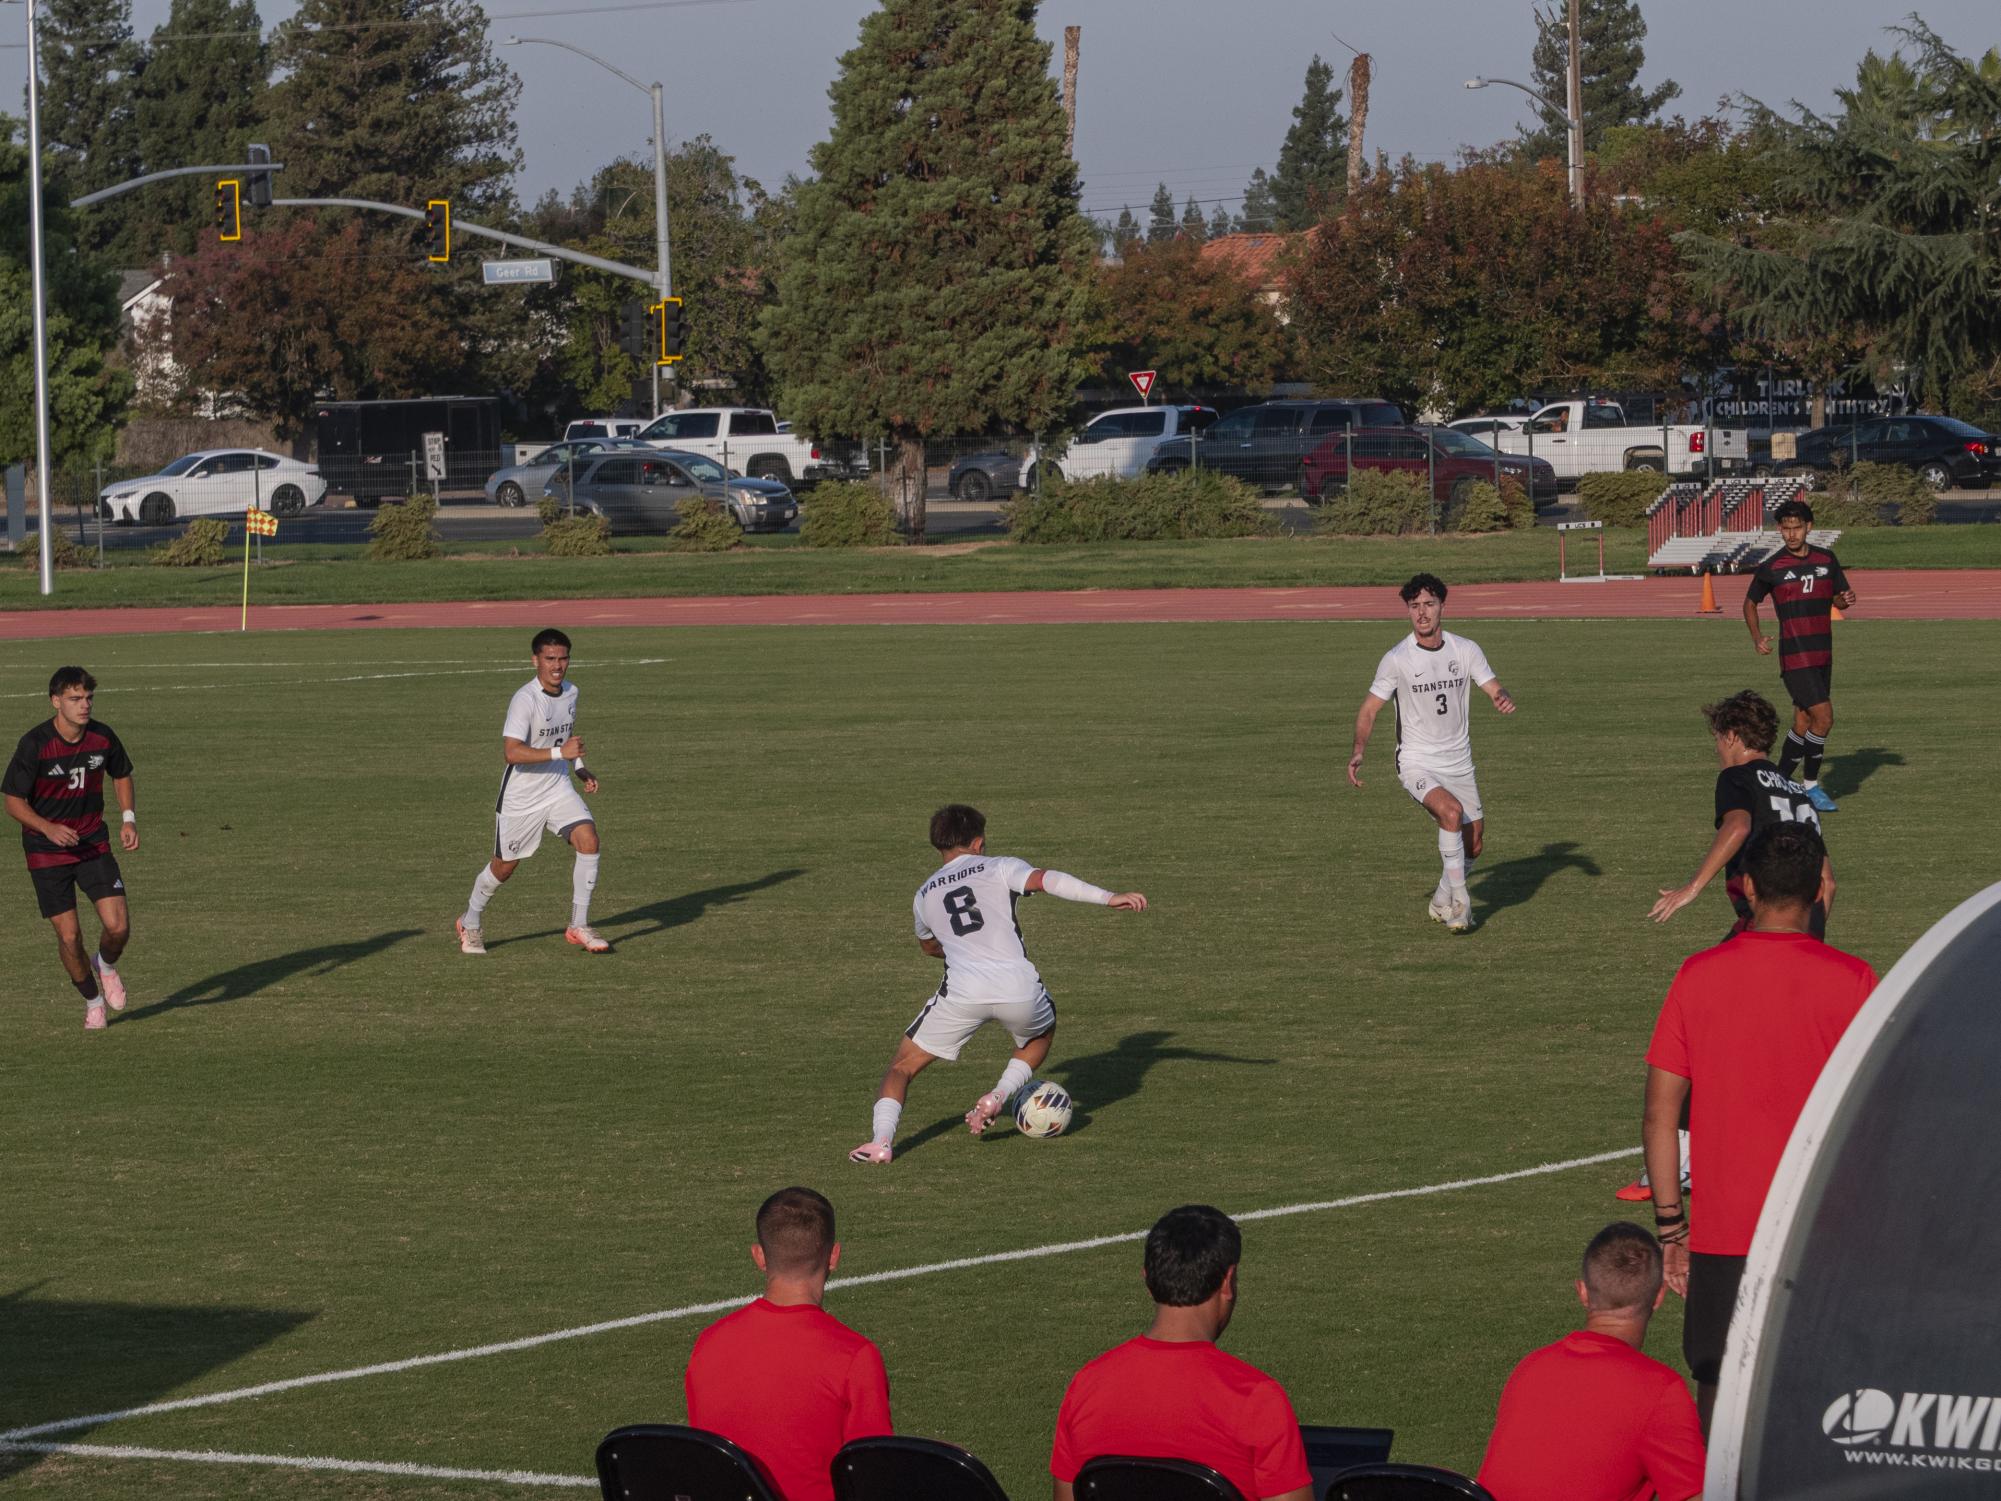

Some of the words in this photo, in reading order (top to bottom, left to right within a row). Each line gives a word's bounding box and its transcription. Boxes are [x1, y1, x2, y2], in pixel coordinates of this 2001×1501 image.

[496, 267, 520, 277] Geer
[525, 265, 538, 276] Rd
[1715, 401, 1800, 416] CHILDREN'S
[1806, 399, 1888, 415] DNTISTRY
[1800, 574, 1814, 594] 27
[1412, 682, 1437, 693] STAN
[1437, 678, 1464, 690] STATE
[1436, 693, 1448, 715] 3
[539, 726, 560, 737] STAN
[68, 767, 86, 790] 31
[921, 863, 985, 899] WARRIORS
[943, 885, 985, 937] 8
[1890, 1392, 2001, 1451] KWI
